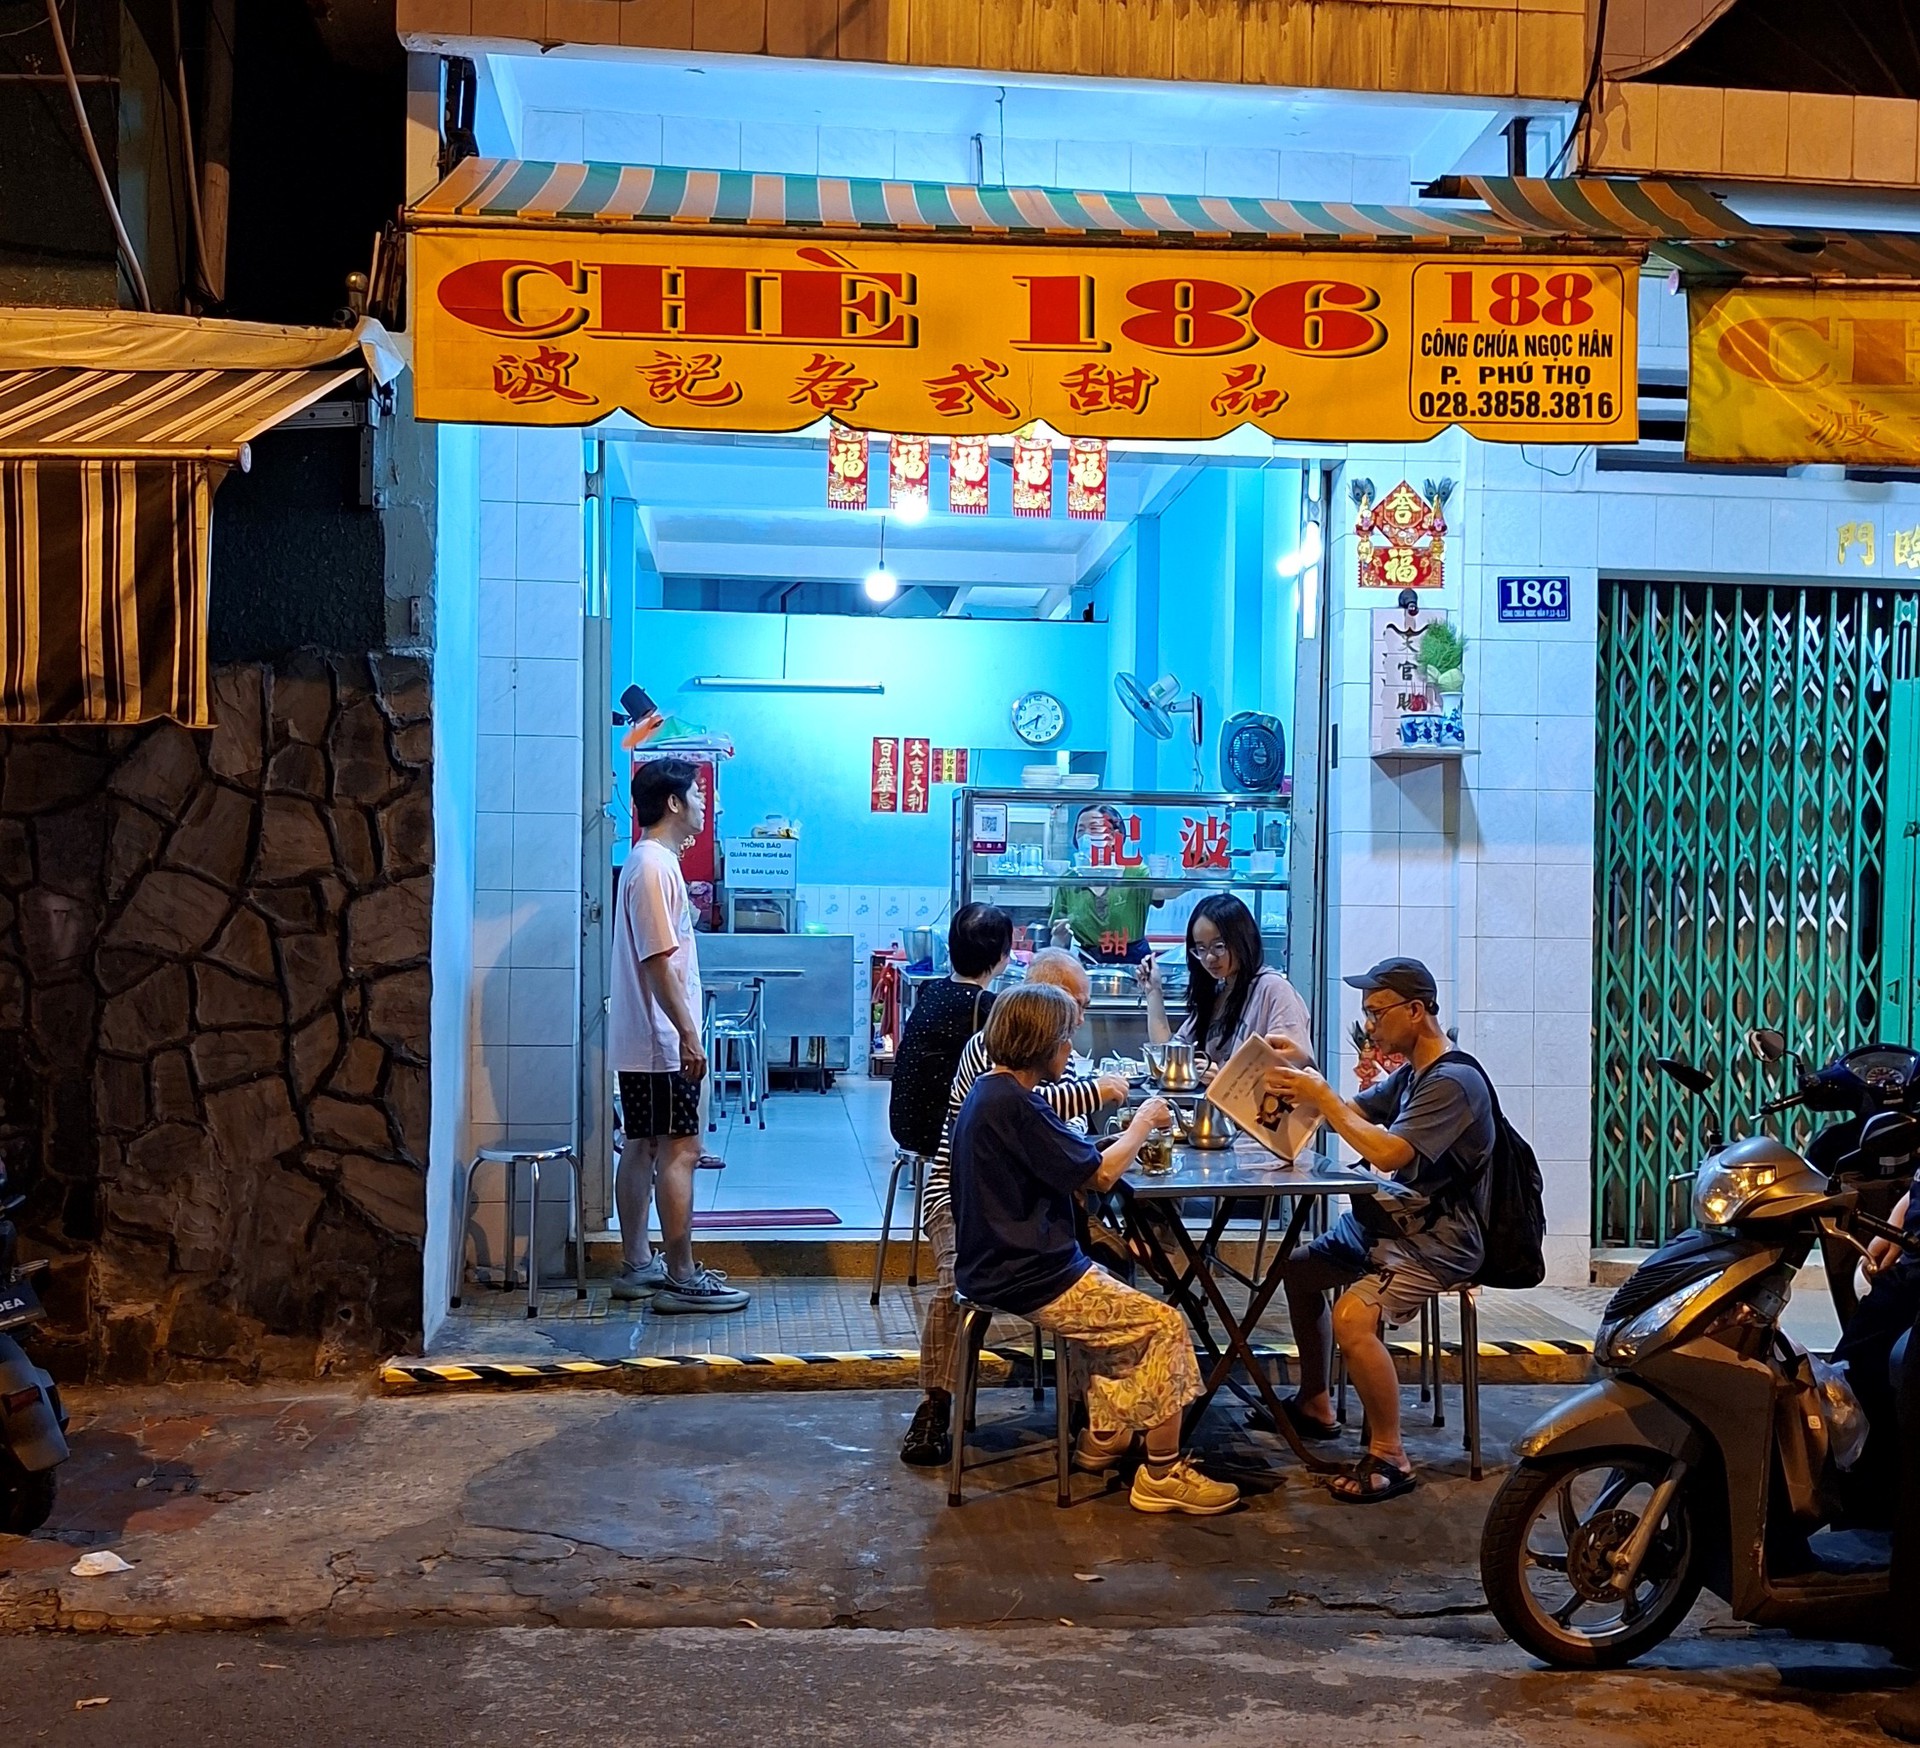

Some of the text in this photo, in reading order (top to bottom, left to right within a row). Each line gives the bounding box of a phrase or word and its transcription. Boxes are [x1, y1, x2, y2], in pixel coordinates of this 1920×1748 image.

[437, 246, 1388, 359] CHÈ 186
[1442, 271, 1594, 326] 188
[1421, 328, 1613, 362] CÔNG CHÚA NGỌC HÂN
[1441, 361, 1591, 389] P. PHÚ THỌ
[1419, 391, 1613, 419] 028.3858.3816
[1384, 548, 1418, 583] 福
[1506, 580, 1563, 607] 186
[907, 739, 927, 811] 大吉大利
[1098, 927, 1130, 957] 甜
